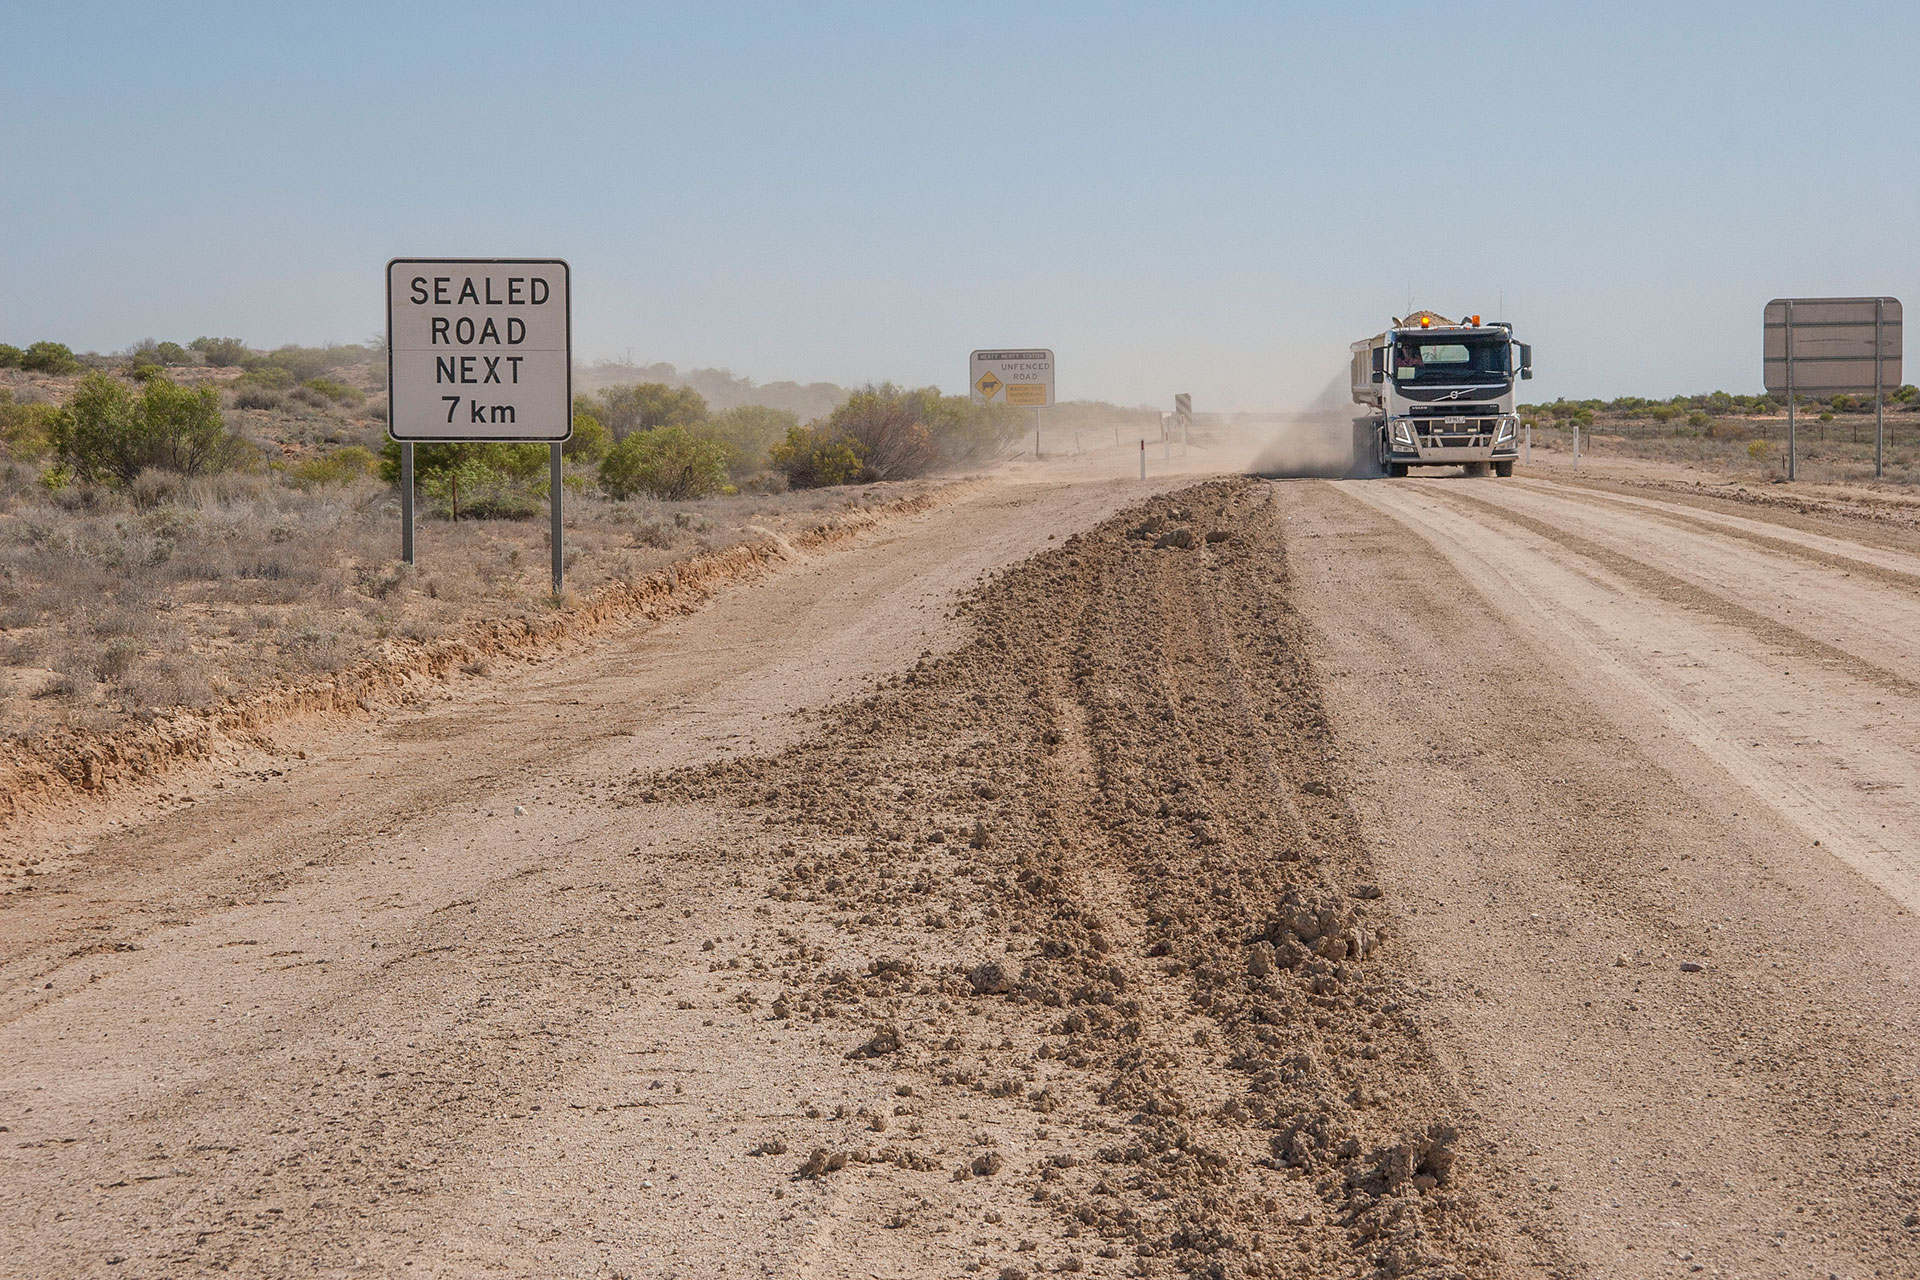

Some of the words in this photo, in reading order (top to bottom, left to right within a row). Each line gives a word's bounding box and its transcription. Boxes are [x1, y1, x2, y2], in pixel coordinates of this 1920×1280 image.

[410, 276, 550, 305] SEALED
[431, 317, 526, 345] ROAD
[436, 356, 524, 384] NEXT
[1001, 363, 1050, 371] UNFENCED
[441, 395, 461, 423] 7
[470, 400, 516, 423] km
